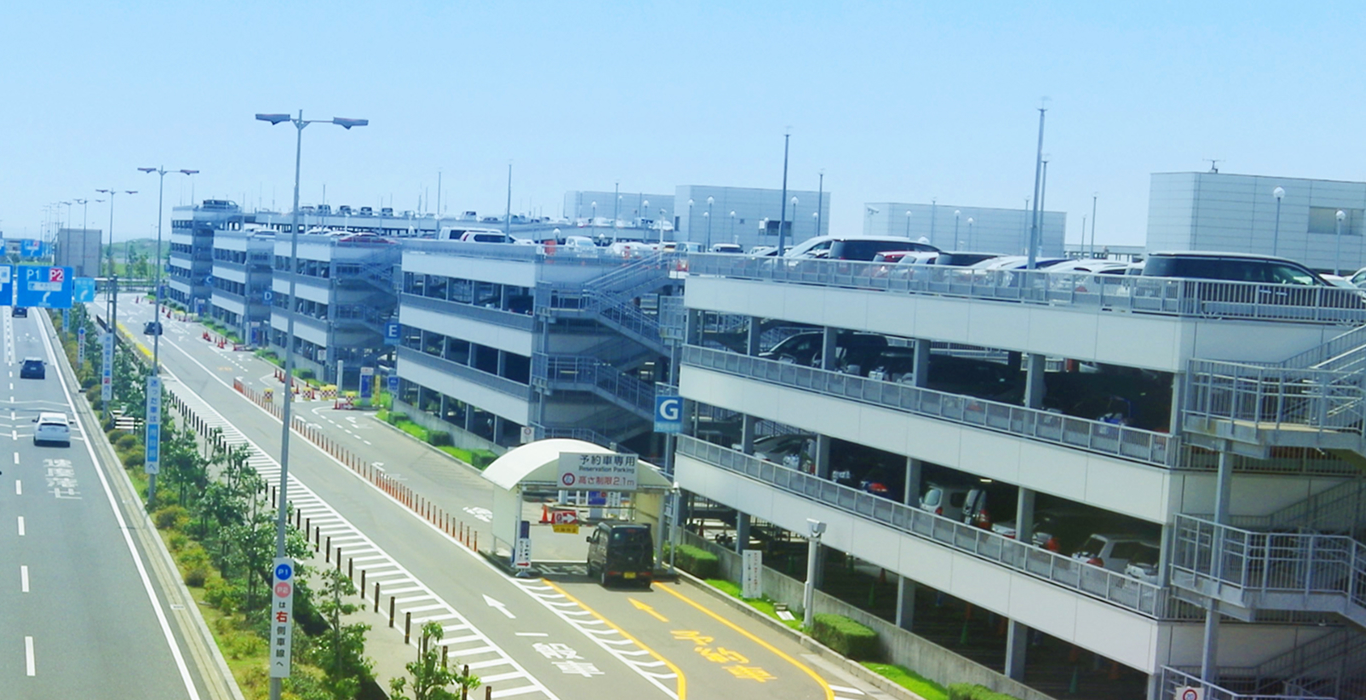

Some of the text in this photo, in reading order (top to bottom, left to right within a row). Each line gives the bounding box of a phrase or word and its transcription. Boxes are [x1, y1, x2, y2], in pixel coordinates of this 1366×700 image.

[27, 269, 63, 281] P1 P2
[264, 292, 273, 300] D
[388, 325, 397, 337] E
[659, 399, 679, 421] G
[579, 455, 636, 467] 予約車専用
[578, 475, 635, 486] 高さ制限2.1m
[276, 601, 288, 667] は右側車線へ
